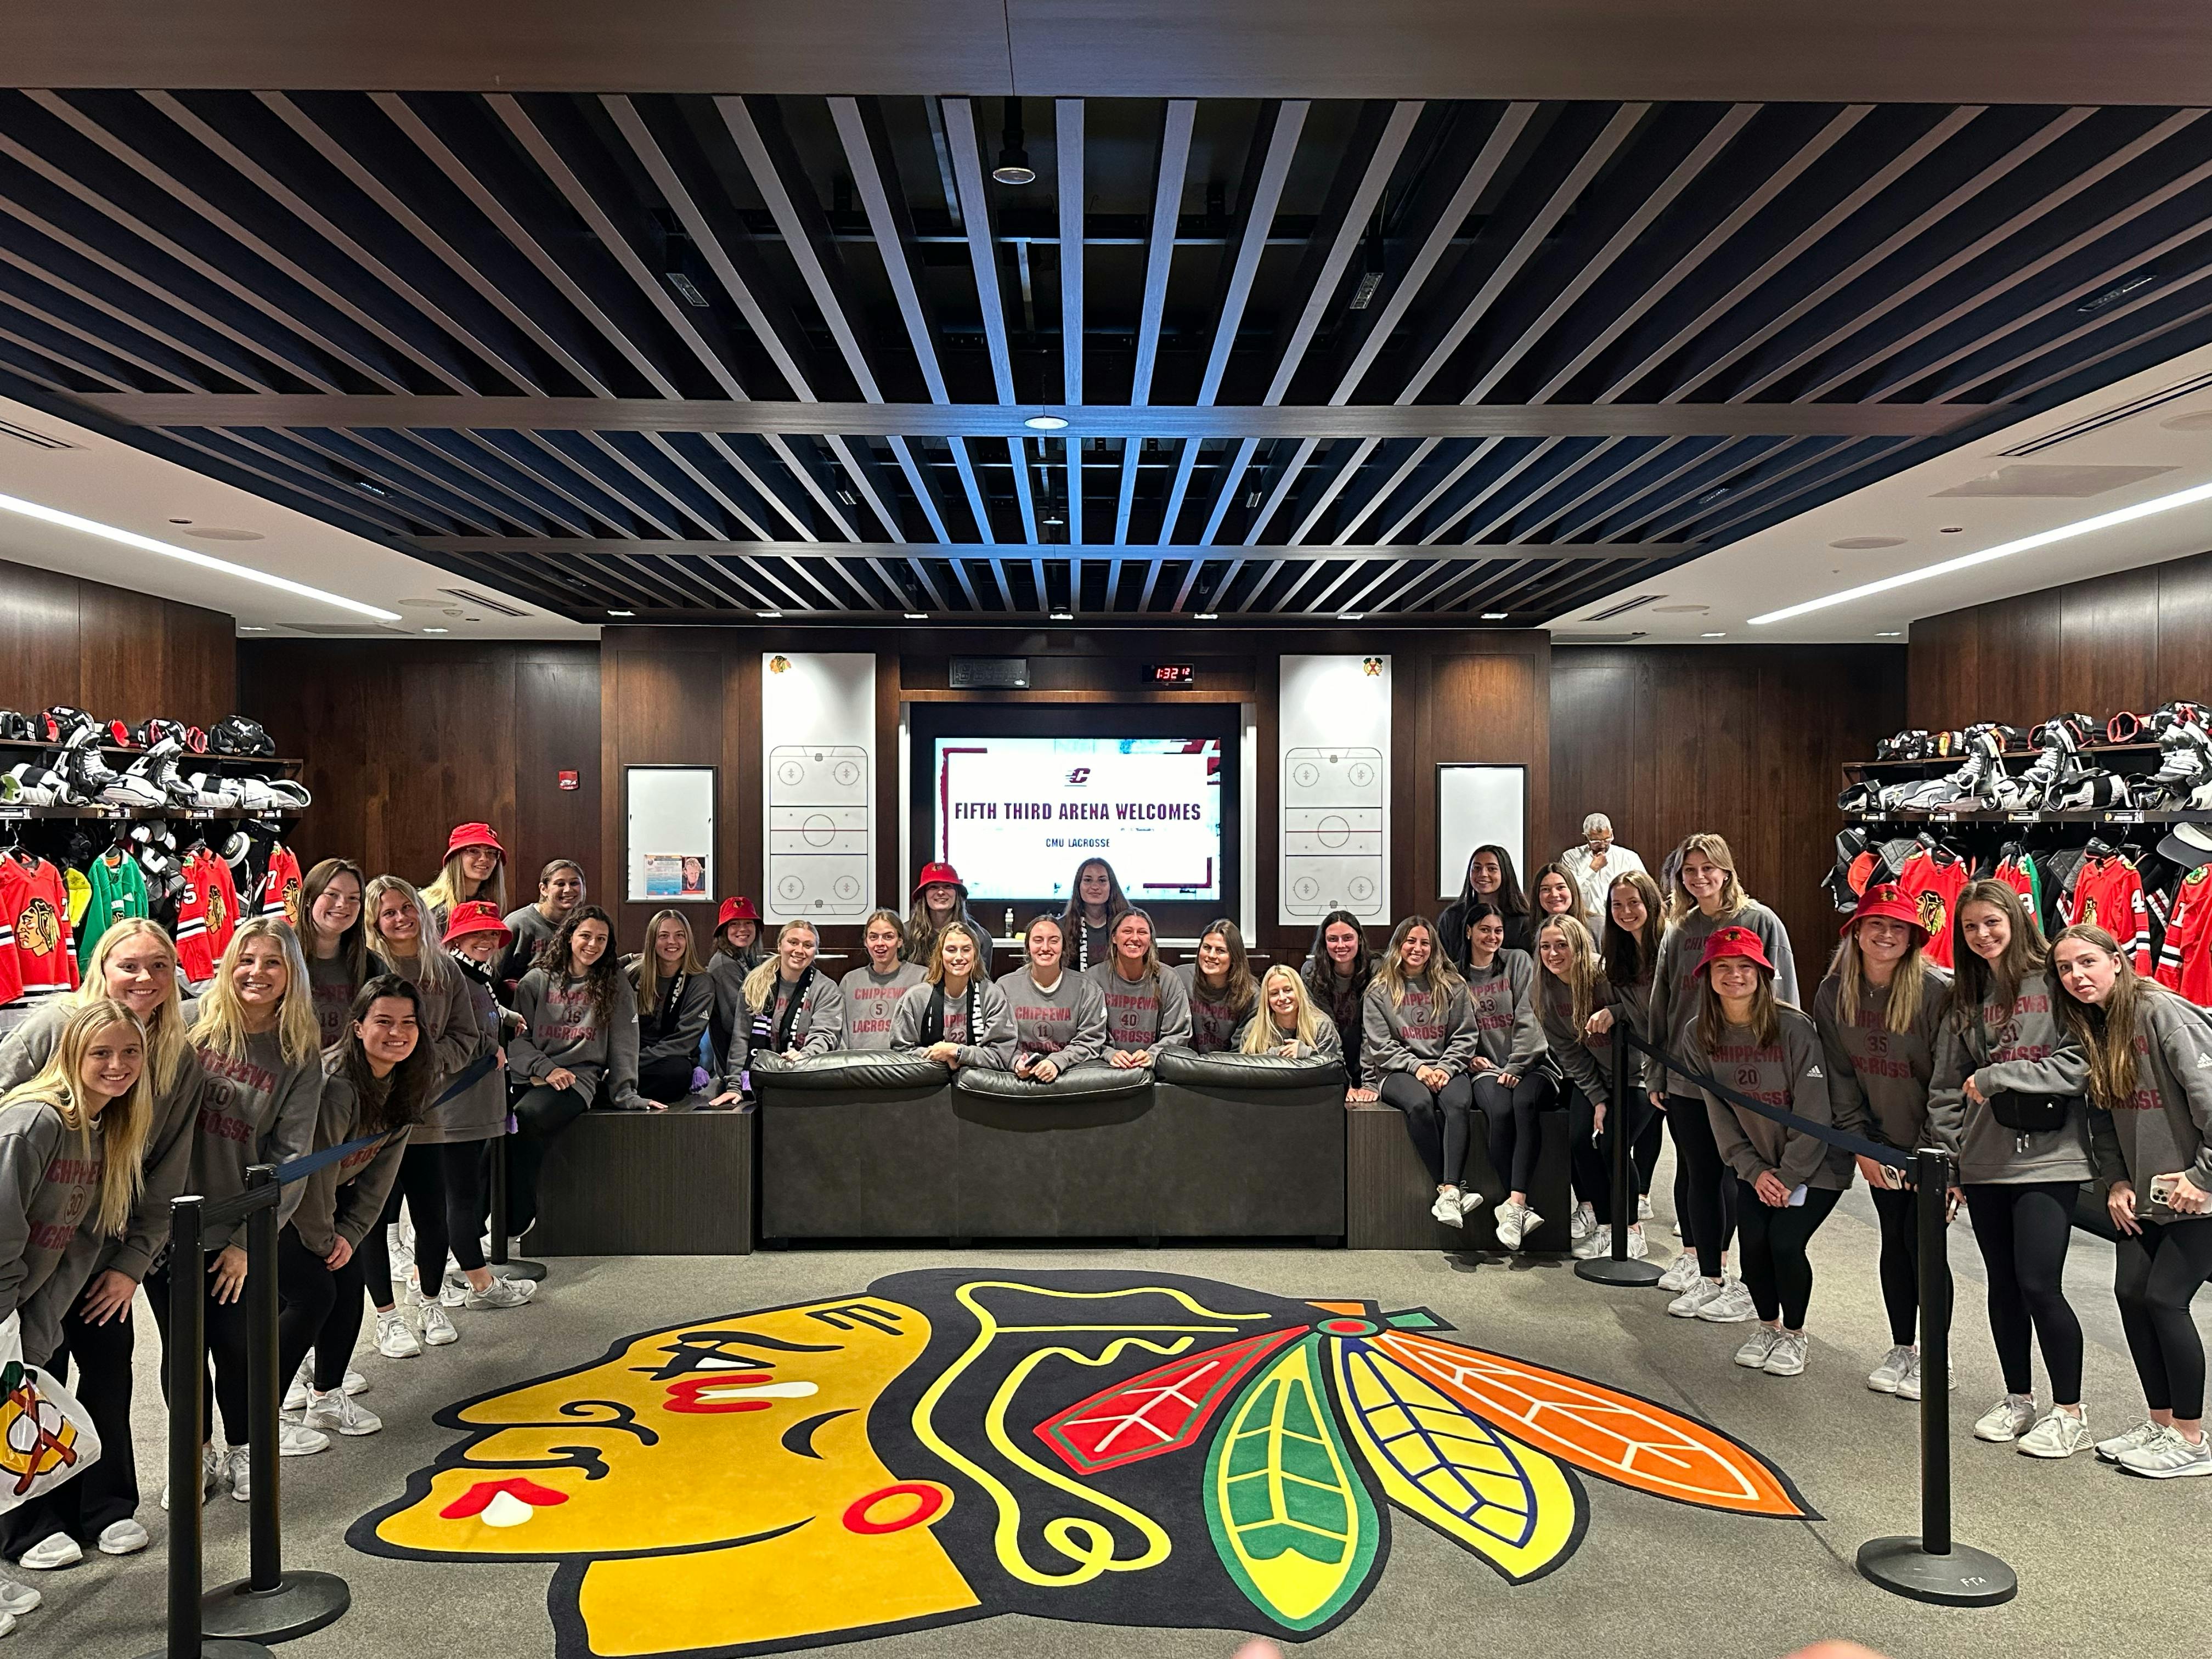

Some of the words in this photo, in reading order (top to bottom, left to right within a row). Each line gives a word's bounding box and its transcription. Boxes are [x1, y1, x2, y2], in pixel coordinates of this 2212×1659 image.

[1156, 668, 1179, 679] 1:32
[955, 803, 997, 820] FIFTH
[1005, 803, 1052, 820] THIRD
[1059, 803, 1109, 820] ARENA
[1116, 803, 1201, 820] WELCOMES
[1046, 838, 1064, 848] CMU
[1068, 838, 1110, 848] LACROSSE
[267, 870, 279, 890] 7
[2131, 888, 2146, 914] 4
[875, 1003, 883, 1015] 5
[1105, 993, 1158, 1011] CHIPPEWA
[321, 1011, 339, 1028] 18
[567, 1009, 581, 1024] 16
[1015, 1006, 1071, 1022] CHIPPEWA
[1121, 1014, 1137, 1026] 40
[1417, 1011, 1425, 1023] 2
[538, 1025, 597, 1042] LACROSSE
[1037, 1025, 1048, 1037] 11
[1203, 1021, 1216, 1033] 41
[950, 1031, 966, 1044] 22
[1867, 1036, 1887, 1052] 35
[1737, 1069, 1758, 1086] 20
[208, 1082, 229, 1106] 10
[66, 1193, 83, 1216] 30
[1960, 1576, 1987, 1588] FTA
